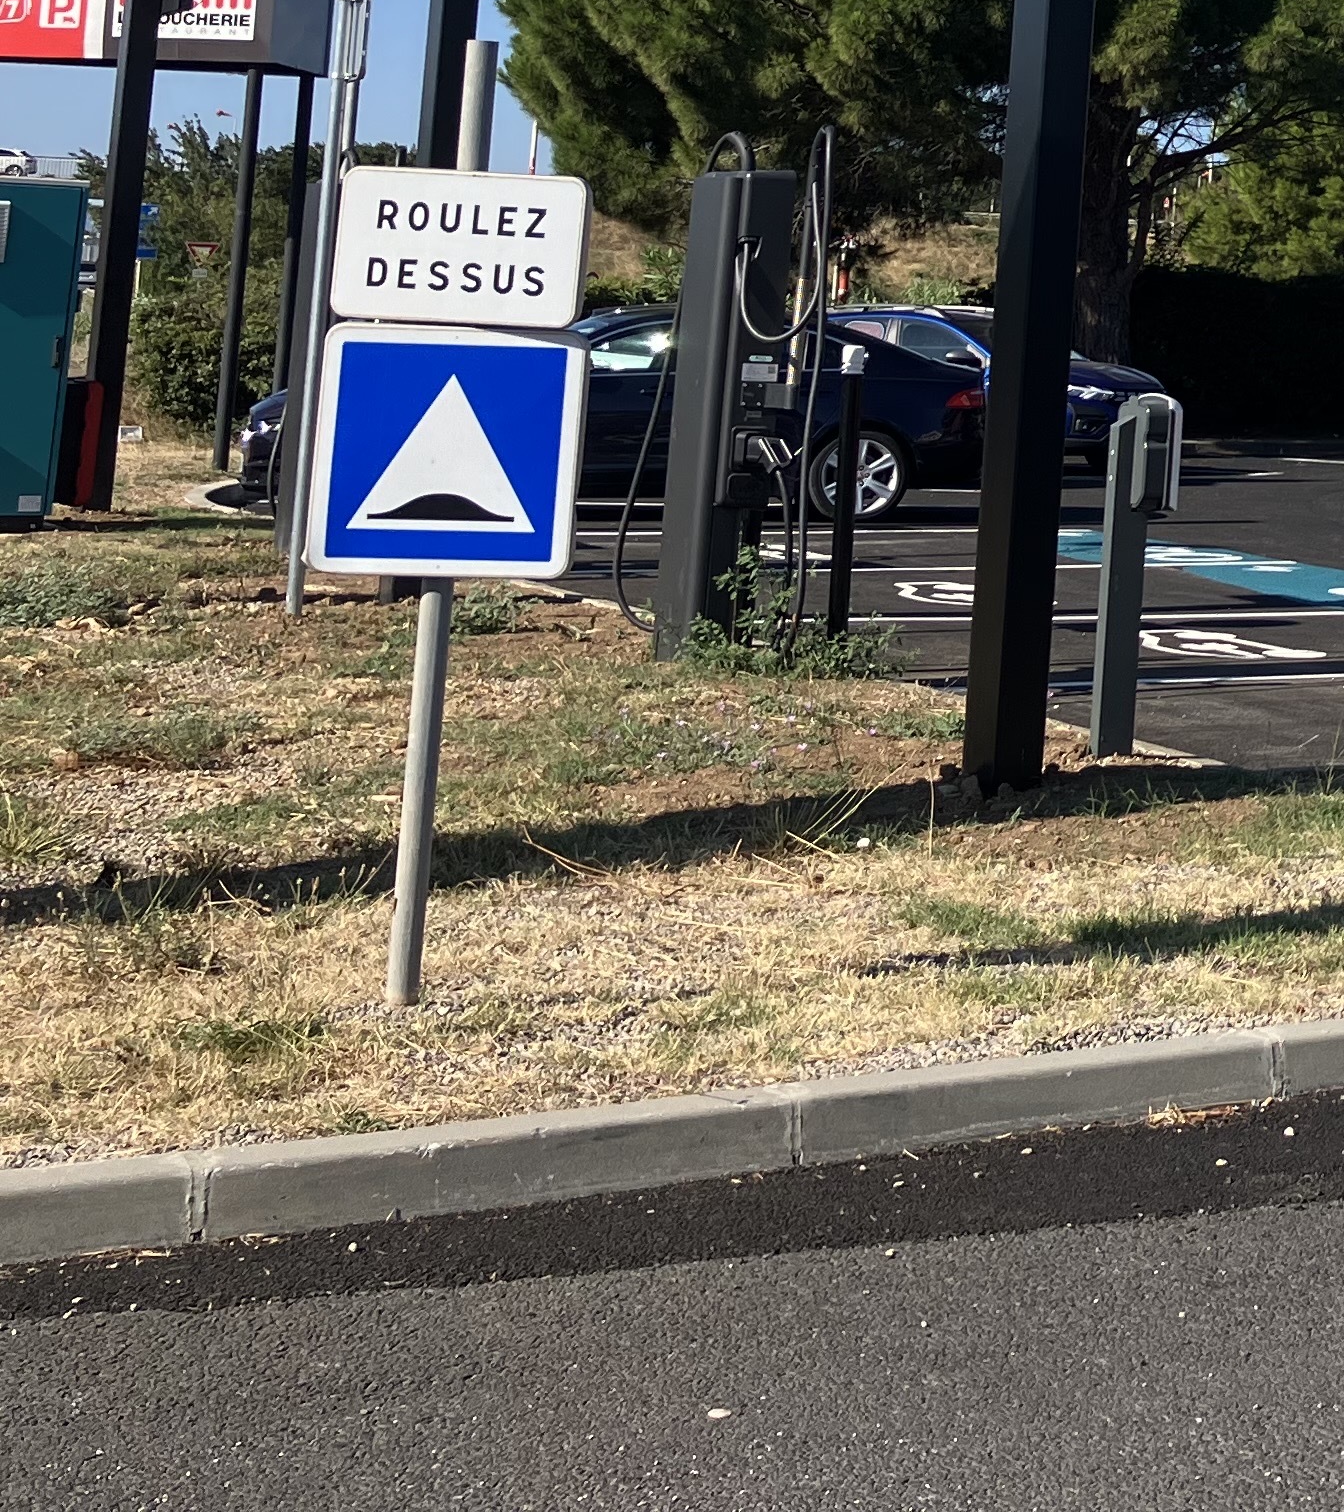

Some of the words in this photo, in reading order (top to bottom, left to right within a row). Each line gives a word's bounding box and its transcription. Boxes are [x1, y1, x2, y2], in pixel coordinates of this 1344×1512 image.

[160, 12, 250, 27] OUCHERIE
[377, 199, 548, 239] ROULEZ
[366, 256, 545, 297] DESSUS
